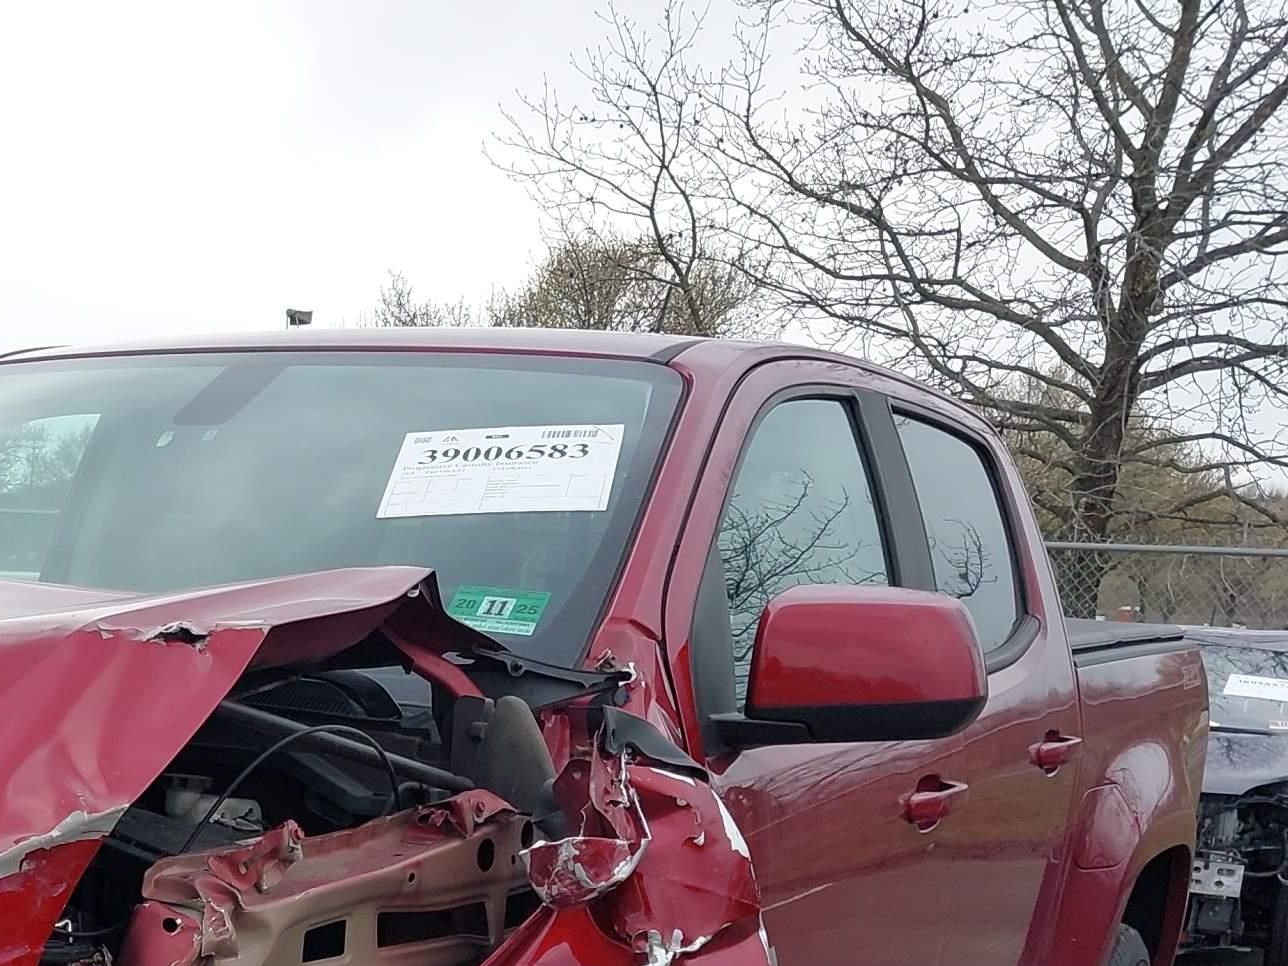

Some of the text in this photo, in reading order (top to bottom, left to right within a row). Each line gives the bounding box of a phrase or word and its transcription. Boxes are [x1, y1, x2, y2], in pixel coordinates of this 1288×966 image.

[417, 443, 589, 464] 39006583
[455, 599, 539, 617] 20 11 25
